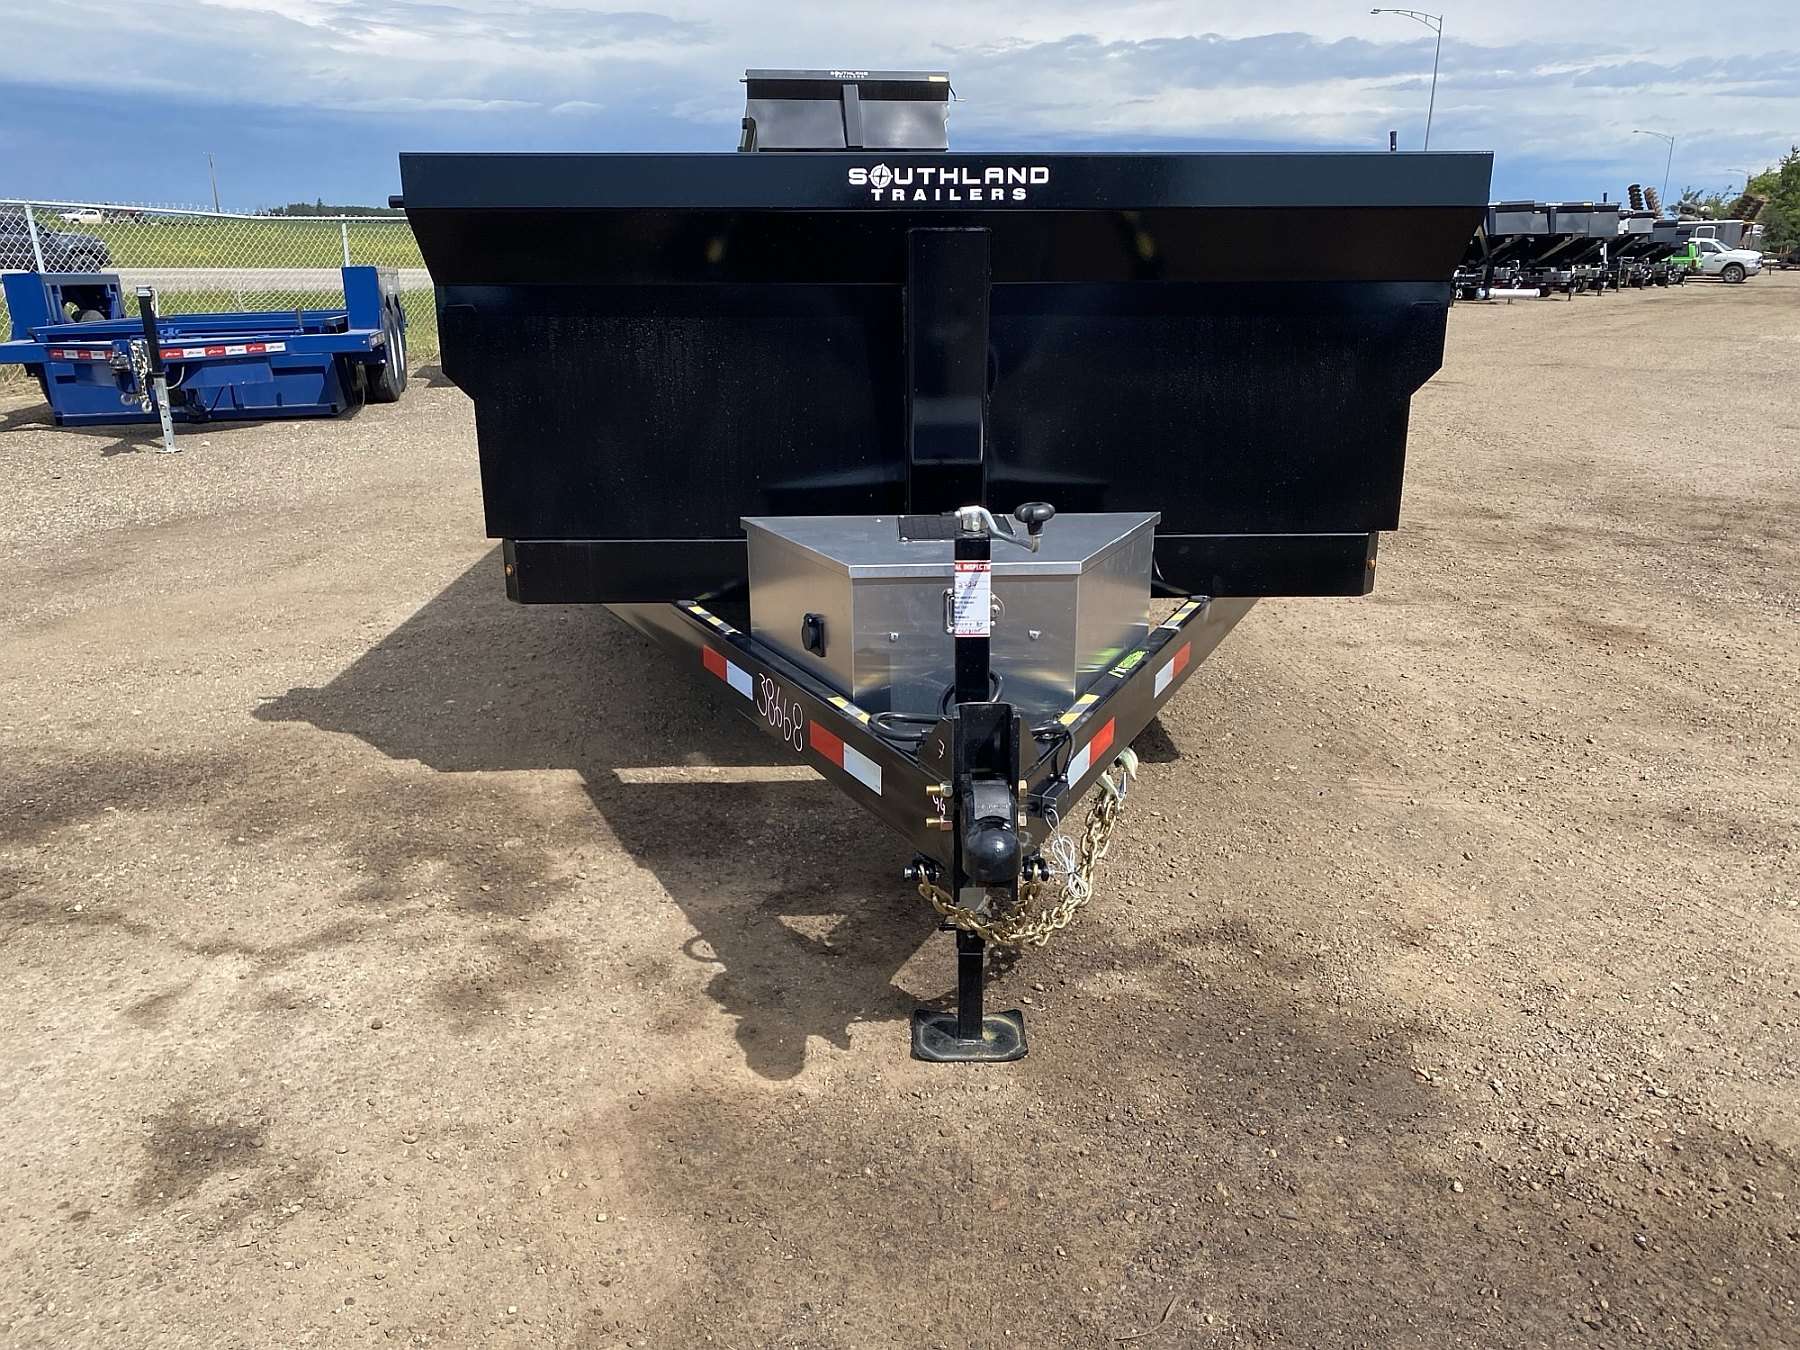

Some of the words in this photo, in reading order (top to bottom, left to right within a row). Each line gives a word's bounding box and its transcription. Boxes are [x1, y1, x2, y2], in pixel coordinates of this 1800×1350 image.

[848, 164, 1050, 187] SOUTHLAND
[871, 188, 1027, 201] TRAILERS
[756, 672, 803, 752] 38668
